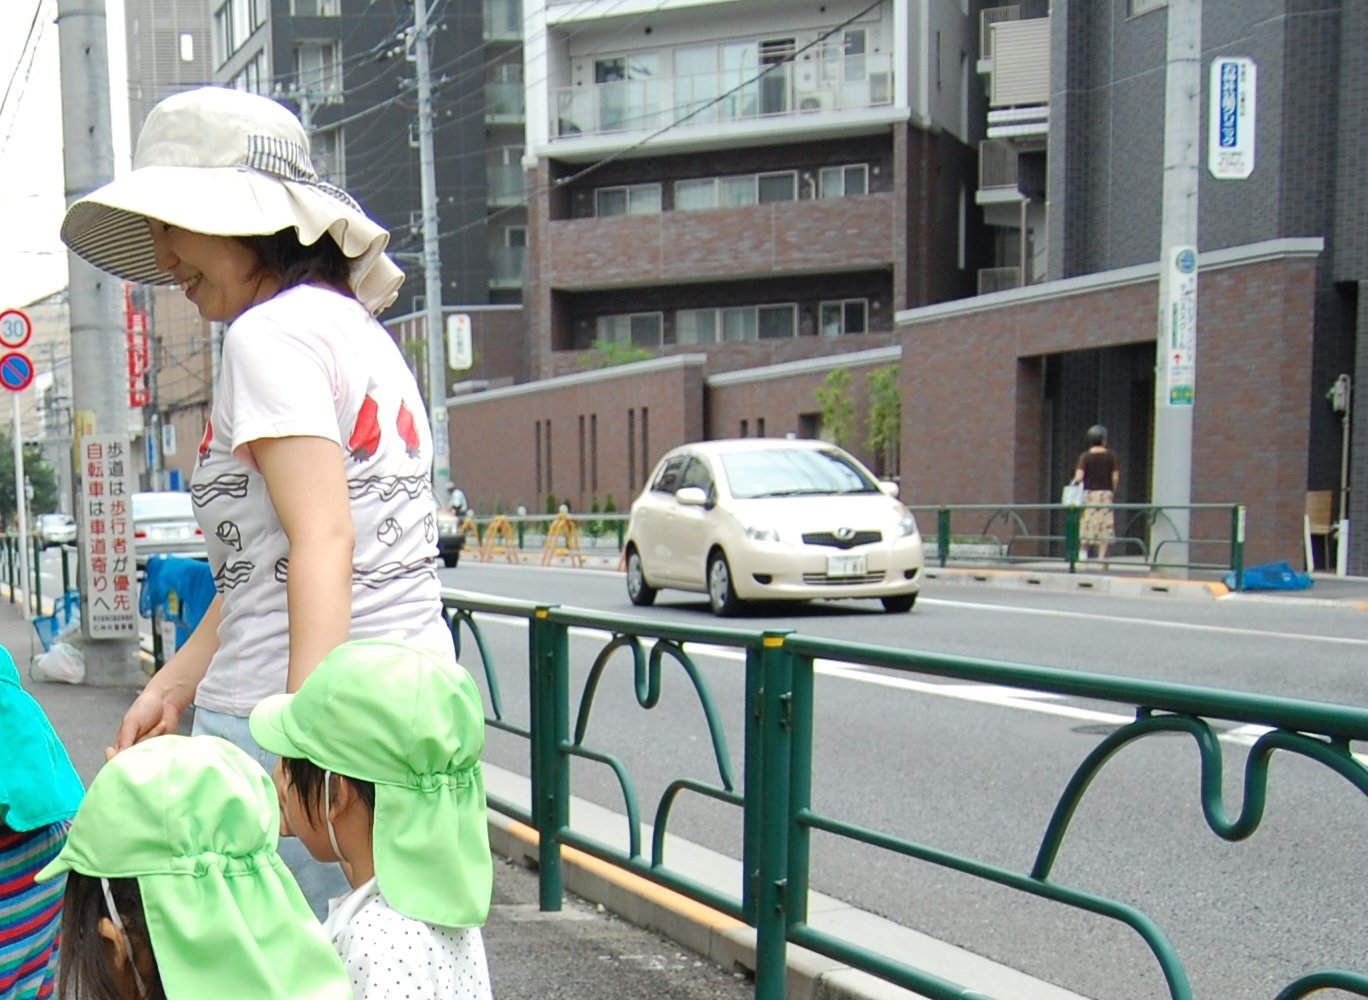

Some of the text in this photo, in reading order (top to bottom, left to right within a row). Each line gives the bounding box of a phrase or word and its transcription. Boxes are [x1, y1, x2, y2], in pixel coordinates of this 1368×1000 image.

[2, 319, 25, 338] 30
[87, 442, 111, 611] 自転車は車道寄りへ
[107, 442, 131, 611] 歩道は歩行者が優先
